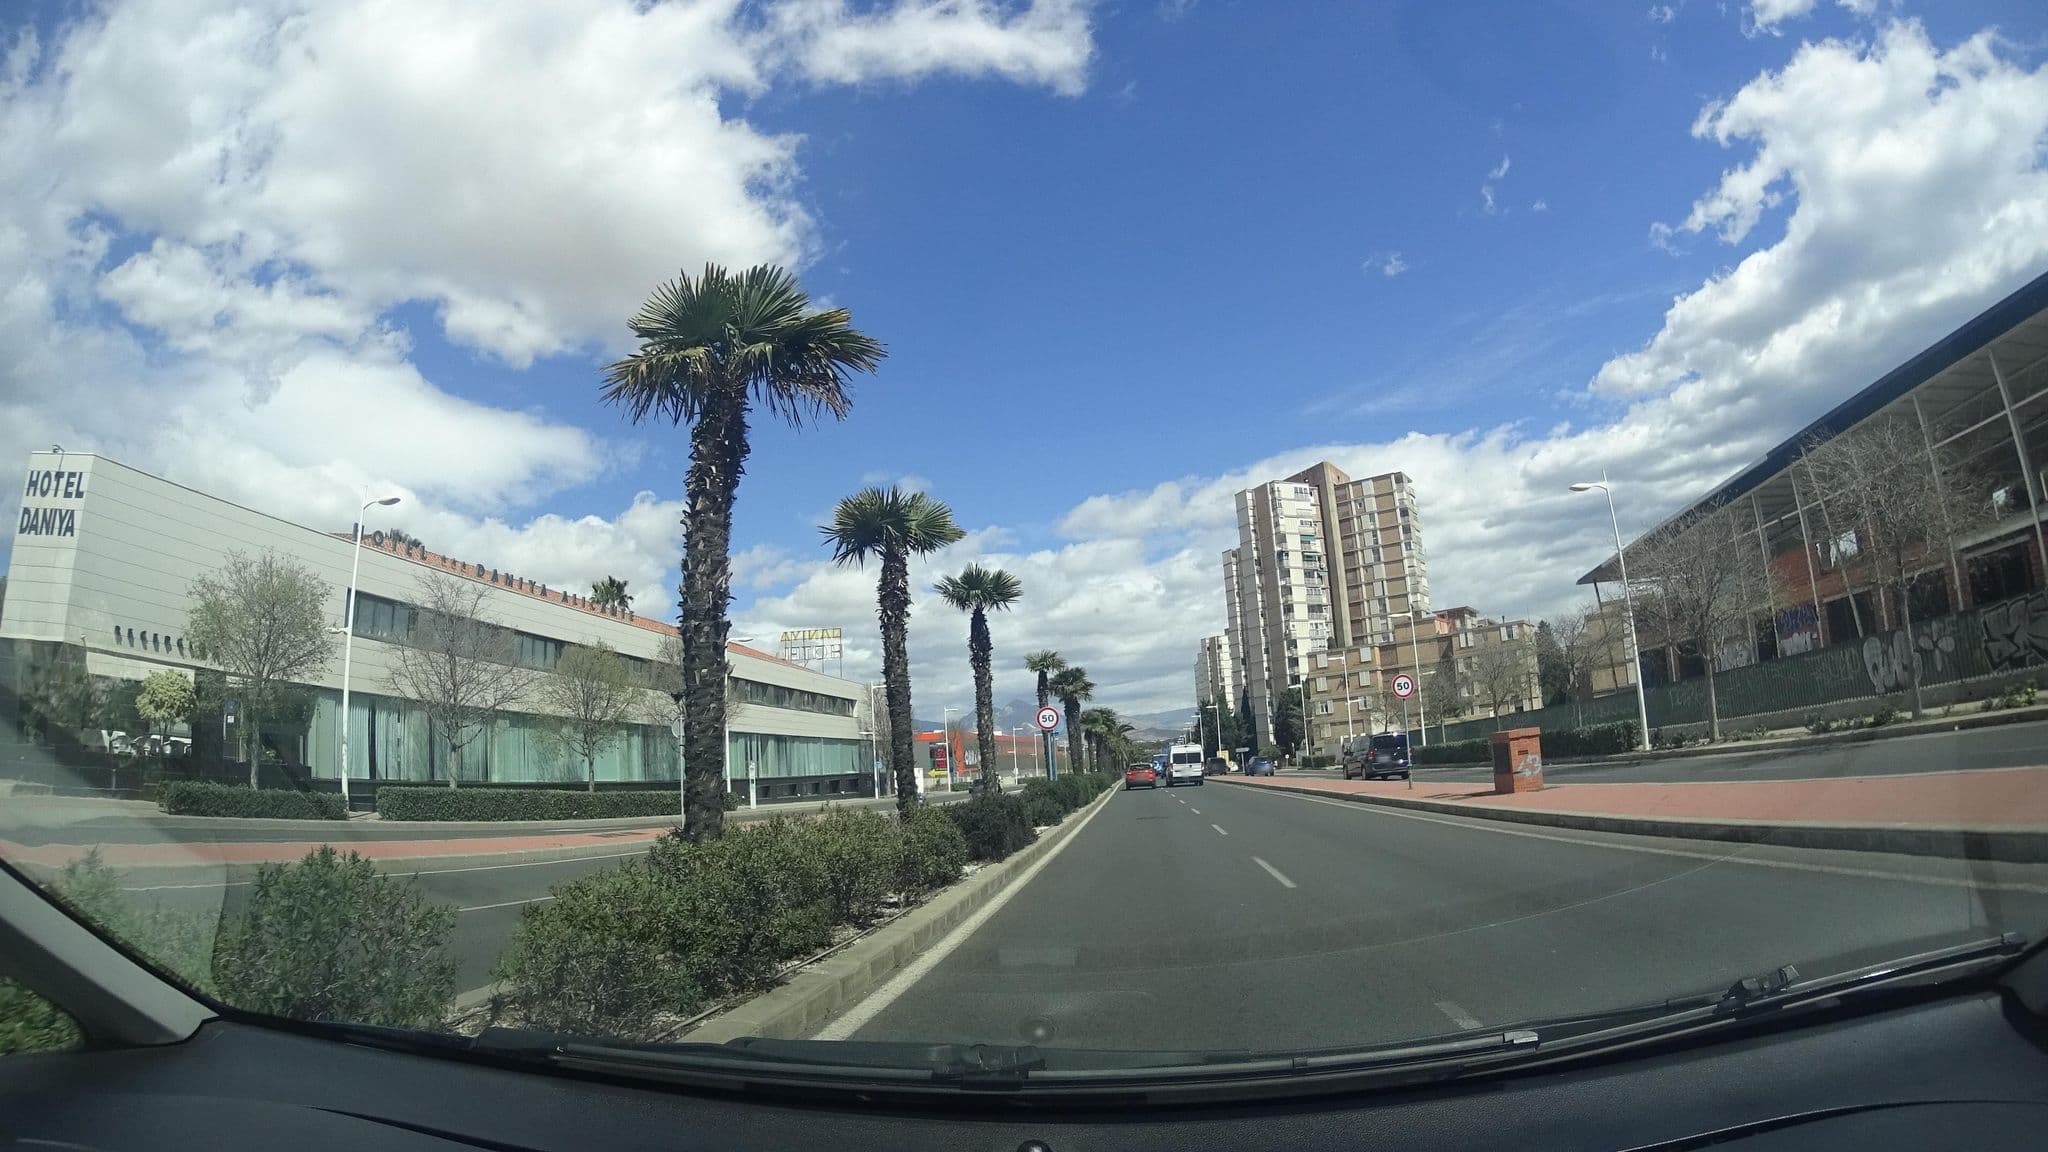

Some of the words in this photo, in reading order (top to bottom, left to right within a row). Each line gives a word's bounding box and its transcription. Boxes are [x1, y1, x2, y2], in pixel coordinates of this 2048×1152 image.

[26, 470, 85, 499] HOTEL
[18, 507, 76, 537] DANIYA
[1396, 681, 1410, 692] 50
[1041, 714, 1055, 723] 50
